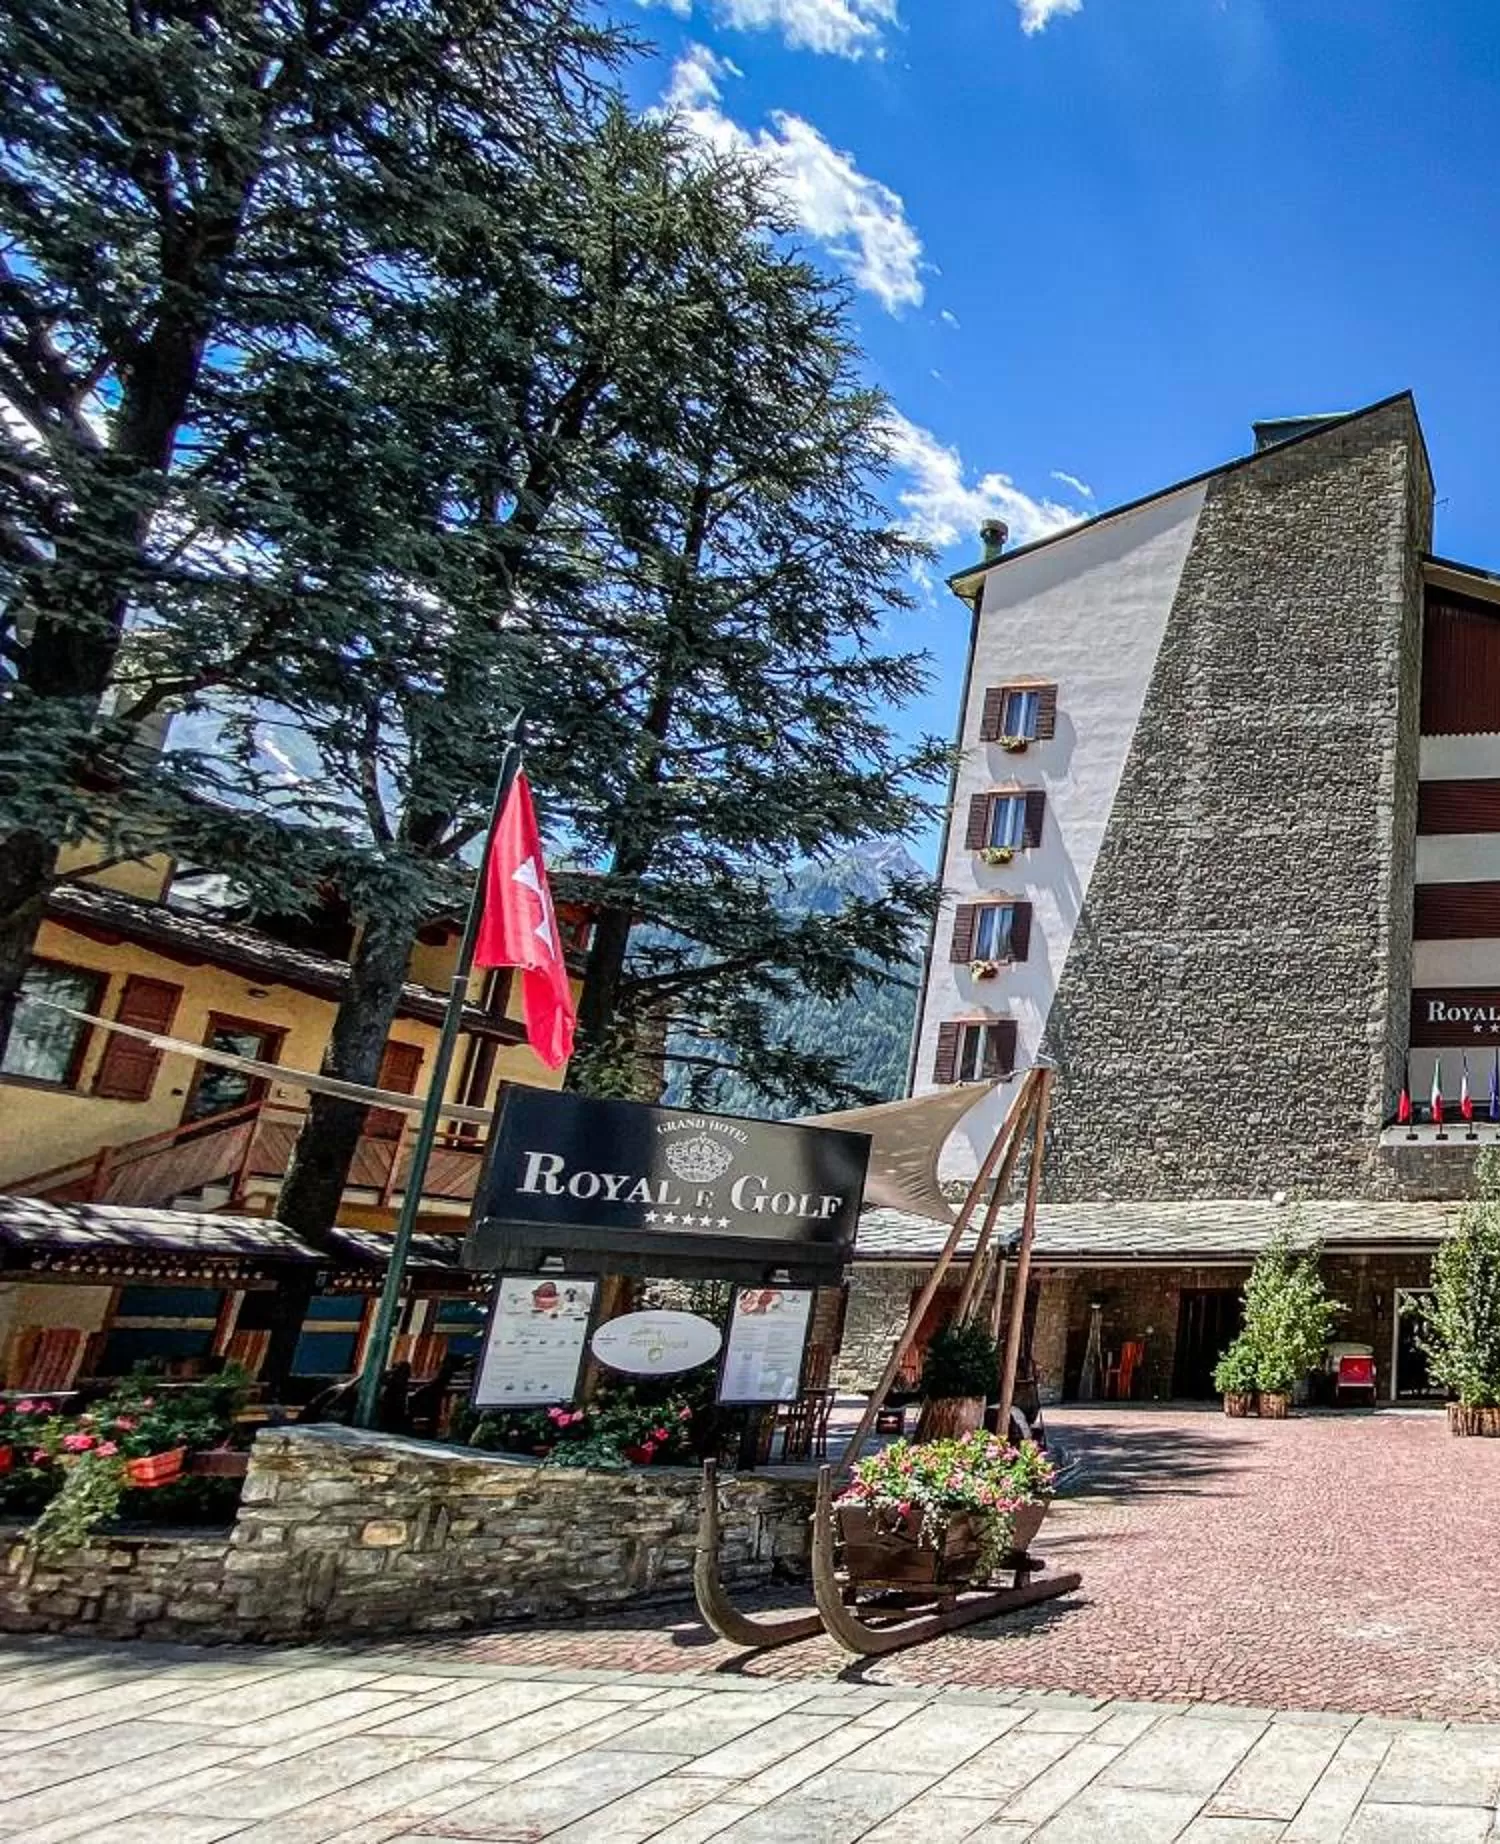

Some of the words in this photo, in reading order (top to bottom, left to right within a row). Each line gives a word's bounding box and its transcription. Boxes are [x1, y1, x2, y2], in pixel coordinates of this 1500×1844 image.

[1428, 1000, 1500, 1022] ROYAL
[656, 1118, 706, 1136] GRAND
[708, 1118, 750, 1146] HOTEL
[516, 1151, 681, 1205] ROYAL
[695, 1190, 715, 1209] E
[731, 1174, 843, 1219] GOLF
